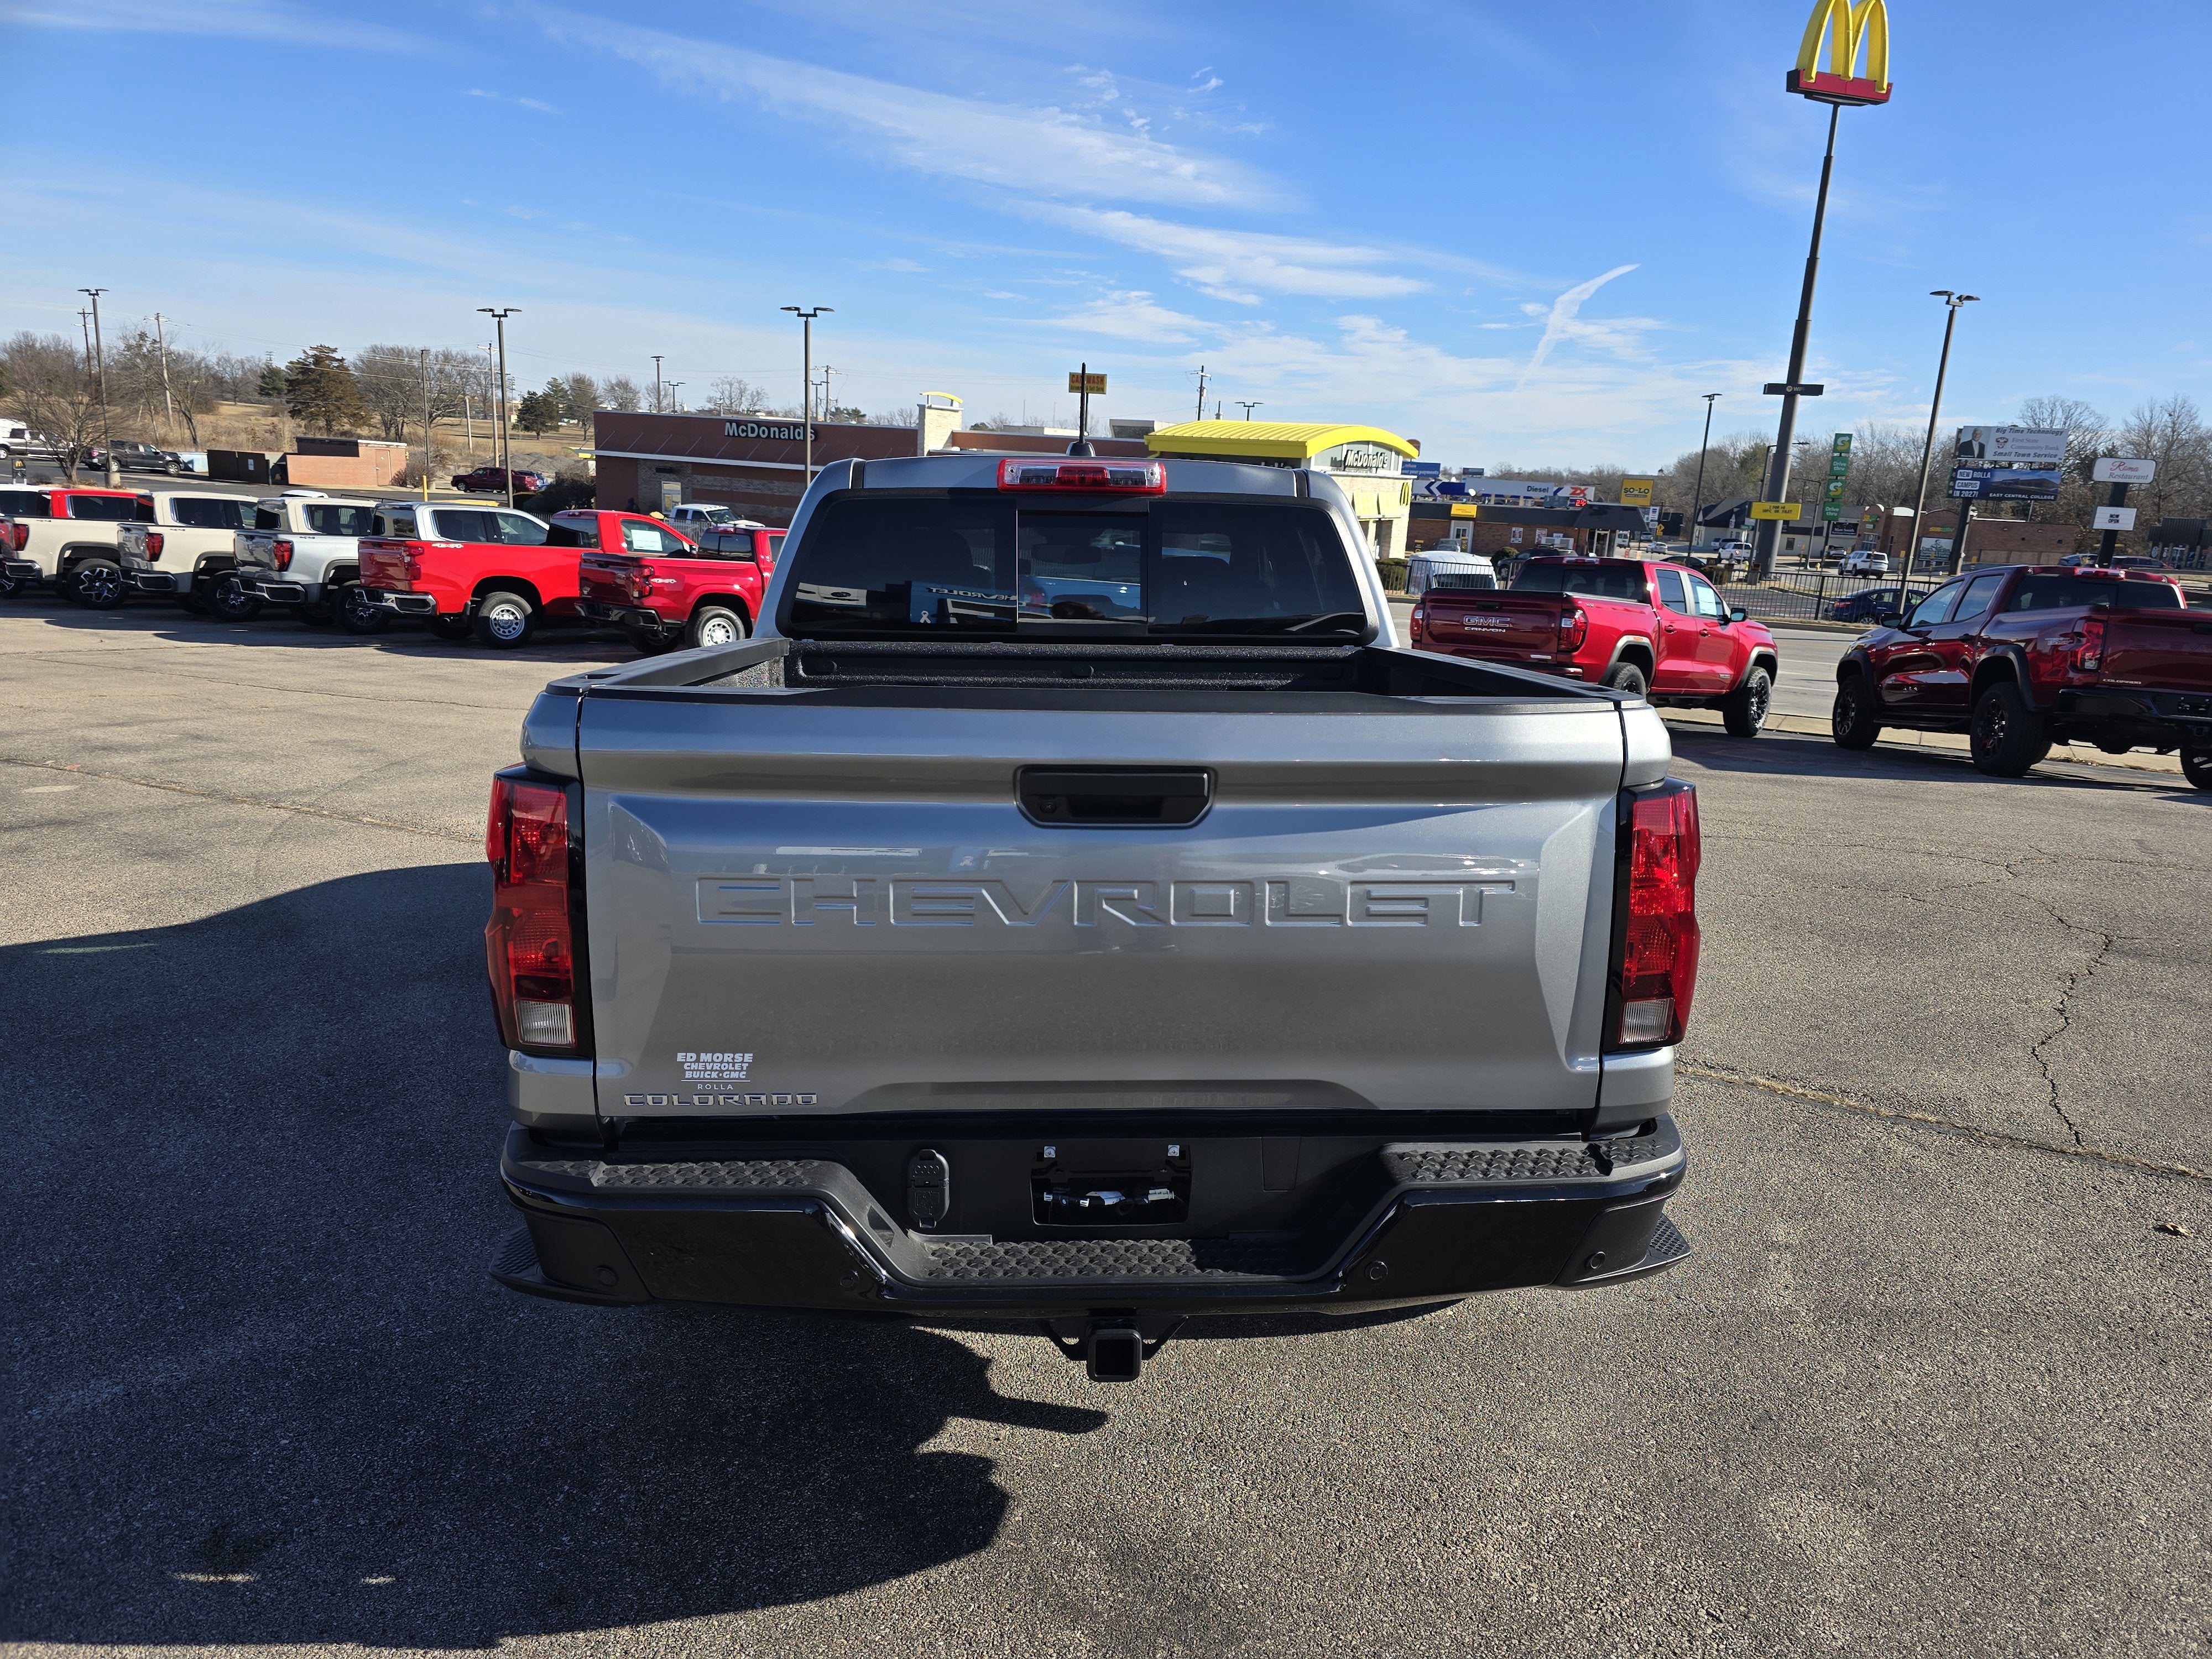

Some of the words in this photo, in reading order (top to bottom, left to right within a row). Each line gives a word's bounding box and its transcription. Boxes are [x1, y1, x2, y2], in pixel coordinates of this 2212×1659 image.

[1086, 375, 1104, 384] WASH
[725, 422, 815, 441] McDonalds
[1463, 615, 1510, 627] GMC
[695, 877, 1516, 927] CHEVROLET
[677, 1052, 697, 1062] ED
[700, 1053, 753, 1062] MORSE
[624, 1092, 818, 1106] COLORADO
